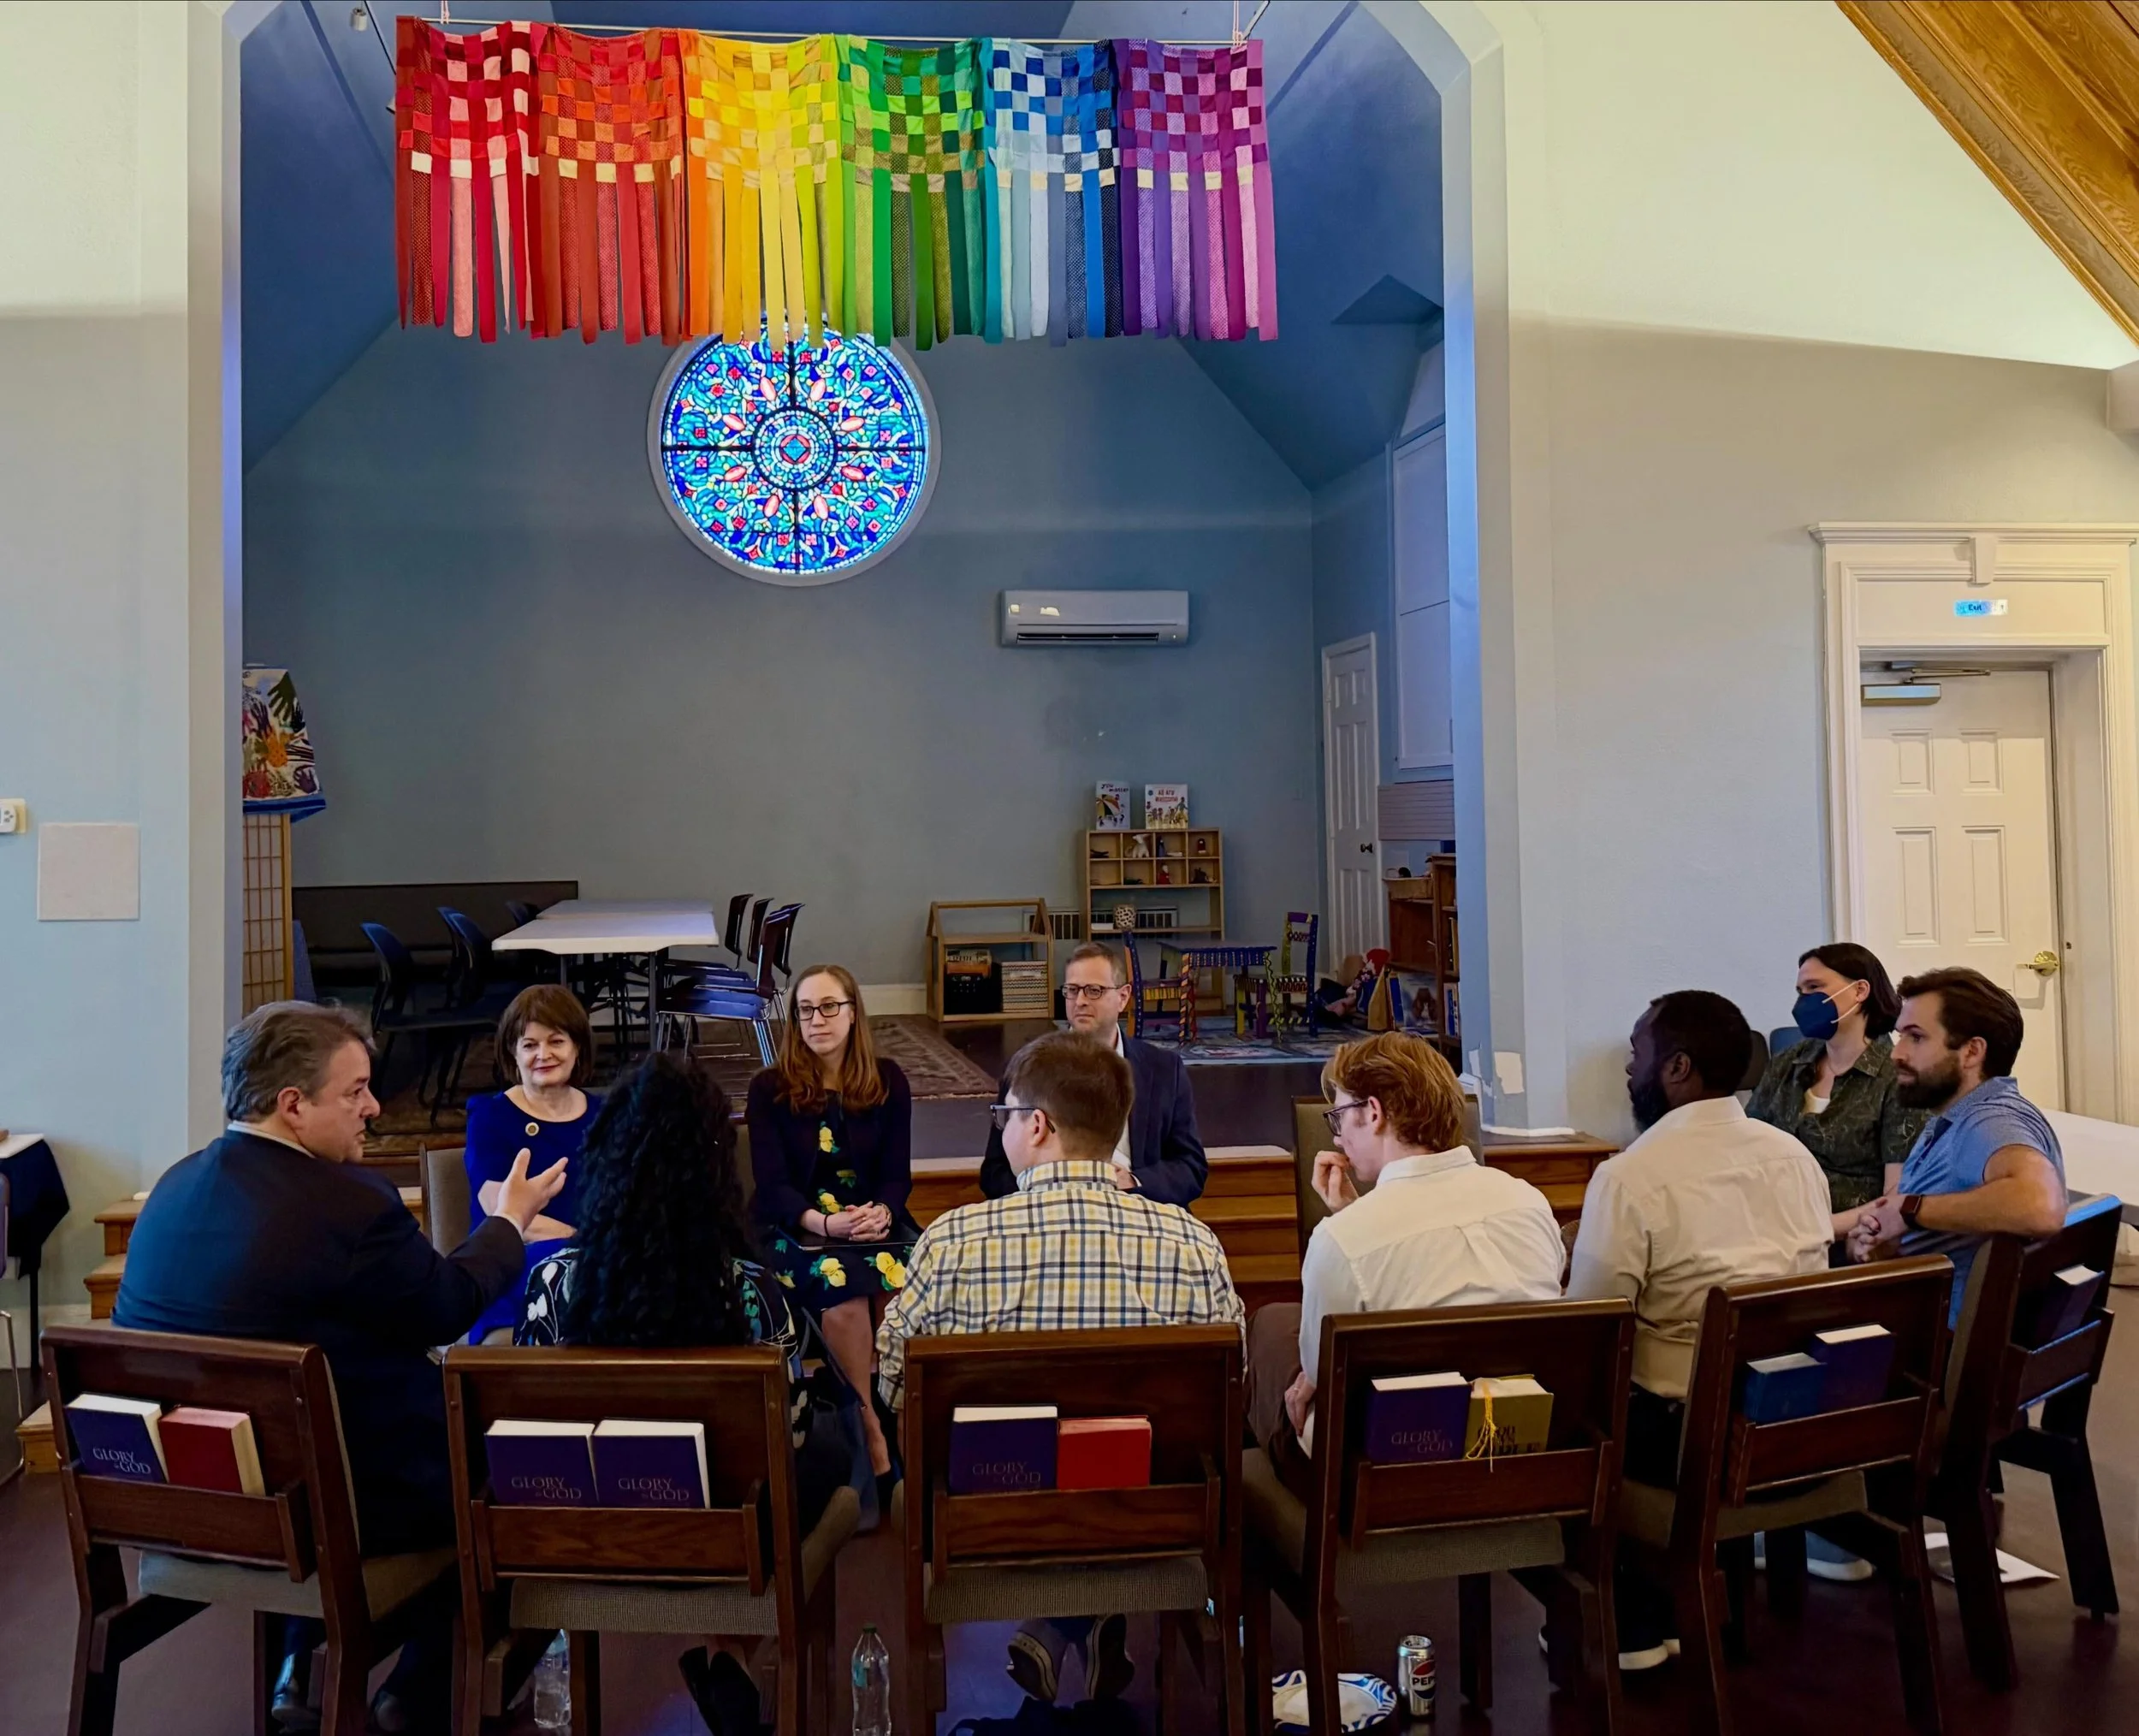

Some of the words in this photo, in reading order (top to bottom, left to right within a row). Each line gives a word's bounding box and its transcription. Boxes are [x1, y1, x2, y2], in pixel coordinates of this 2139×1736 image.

[1390, 1429, 1442, 1445] GLORY
[1417, 1438, 1454, 1454] GOD
[92, 1448, 133, 1464] GLORY
[119, 1460, 151, 1475] GOD
[972, 1460, 1028, 1475] GLORY
[511, 1475, 565, 1490] GLORY
[618, 1478, 673, 1491] GLORY
[1002, 1471, 1041, 1484] GOD
[542, 1487, 582, 1500] GOD
[649, 1488, 690, 1502] GOD
